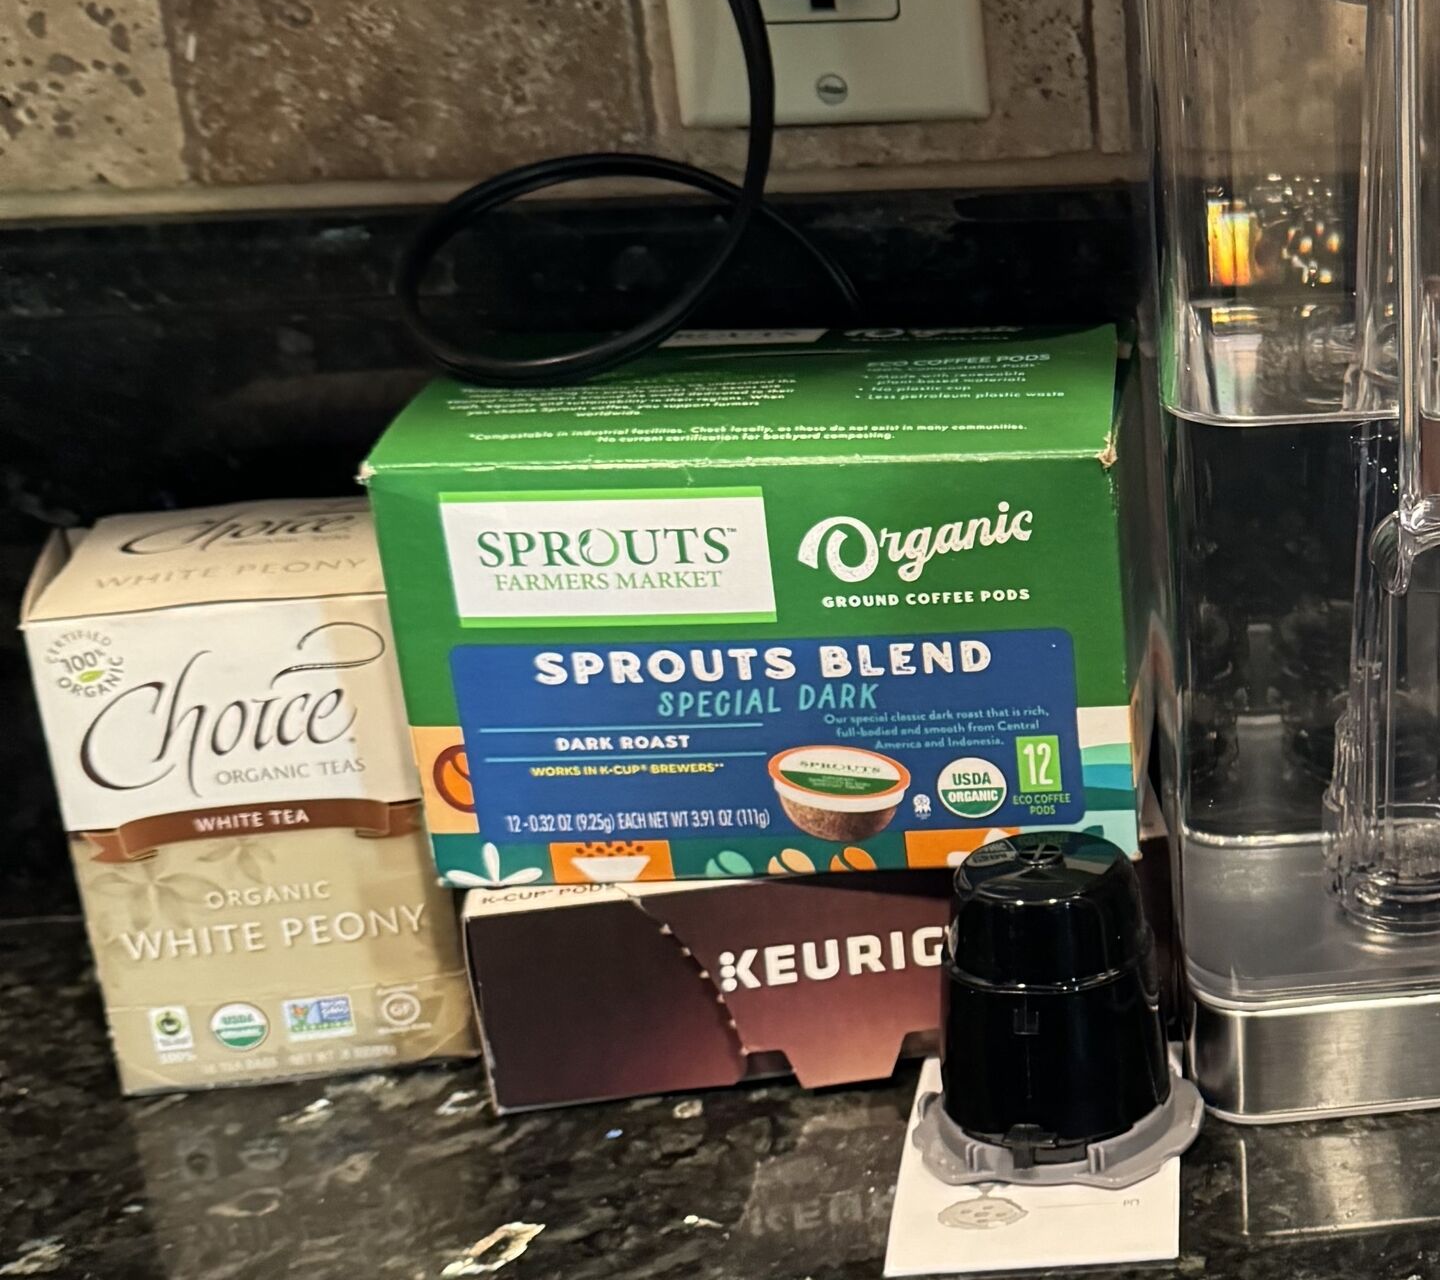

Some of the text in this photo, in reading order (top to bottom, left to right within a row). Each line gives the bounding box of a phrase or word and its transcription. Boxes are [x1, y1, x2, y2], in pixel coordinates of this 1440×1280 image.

[867, 353, 1051, 368] ECO COFFEE PODS
[897, 385, 942, 393] plastic
[900, 392, 971, 400] petroleum
[976, 391, 1021, 399] plastic
[571, 428, 629, 437] industrial
[631, 427, 688, 435] facilities.
[690, 425, 727, 433] Check
[731, 424, 773, 433] locally,
[829, 424, 847, 432] do
[870, 424, 900, 432] exist
[916, 424, 949, 432] many
[951, 423, 1028, 431] communities.
[596, 431, 896, 443] No current certification for backyard composting.
[797, 500, 1034, 583] Organic
[96, 558, 367, 589] WHITE PEONY
[494, 570, 723, 592] FARMERS MARKET
[821, 588, 1031, 609] GROUND COFFEE PODS
[534, 640, 992, 685] SPROUTS BLEND
[56, 656, 124, 698] ORGANIC
[657, 683, 879, 717] SPECIAL DARK
[81, 623, 386, 799] Choice
[824, 705, 1050, 726] Our special classic dark roast that is rich,
[836, 719, 1040, 739] full-bodied and smooth from Central
[555, 735, 690, 752] DARK ROAST
[875, 736, 1004, 750] America and Indonesia.
[216, 757, 367, 785] ORGANIC TEAS
[530, 766, 582, 777] WORKS
[584, 766, 598, 776] IN
[1023, 742, 1054, 786] 12
[951, 772, 992, 786] USDA
[947, 789, 999, 803] ORGANIC
[1012, 792, 1071, 806] ECO COFFEE
[1029, 804, 1056, 815] PODS
[193, 809, 310, 833] WHITE TEA
[558, 814, 573, 832] OZ
[577, 811, 616, 834] (9.25g)
[618, 811, 648, 830] EACH
[649, 810, 670, 829] NET
[671, 810, 690, 828] WT
[692, 809, 717, 828] 3.91
[718, 809, 734, 828] OZ
[737, 807, 771, 830] (111g)
[205, 880, 332, 911] ORGANIC
[121, 902, 426, 962] WHITE PEONY
[718, 925, 944, 993] KEURIG
